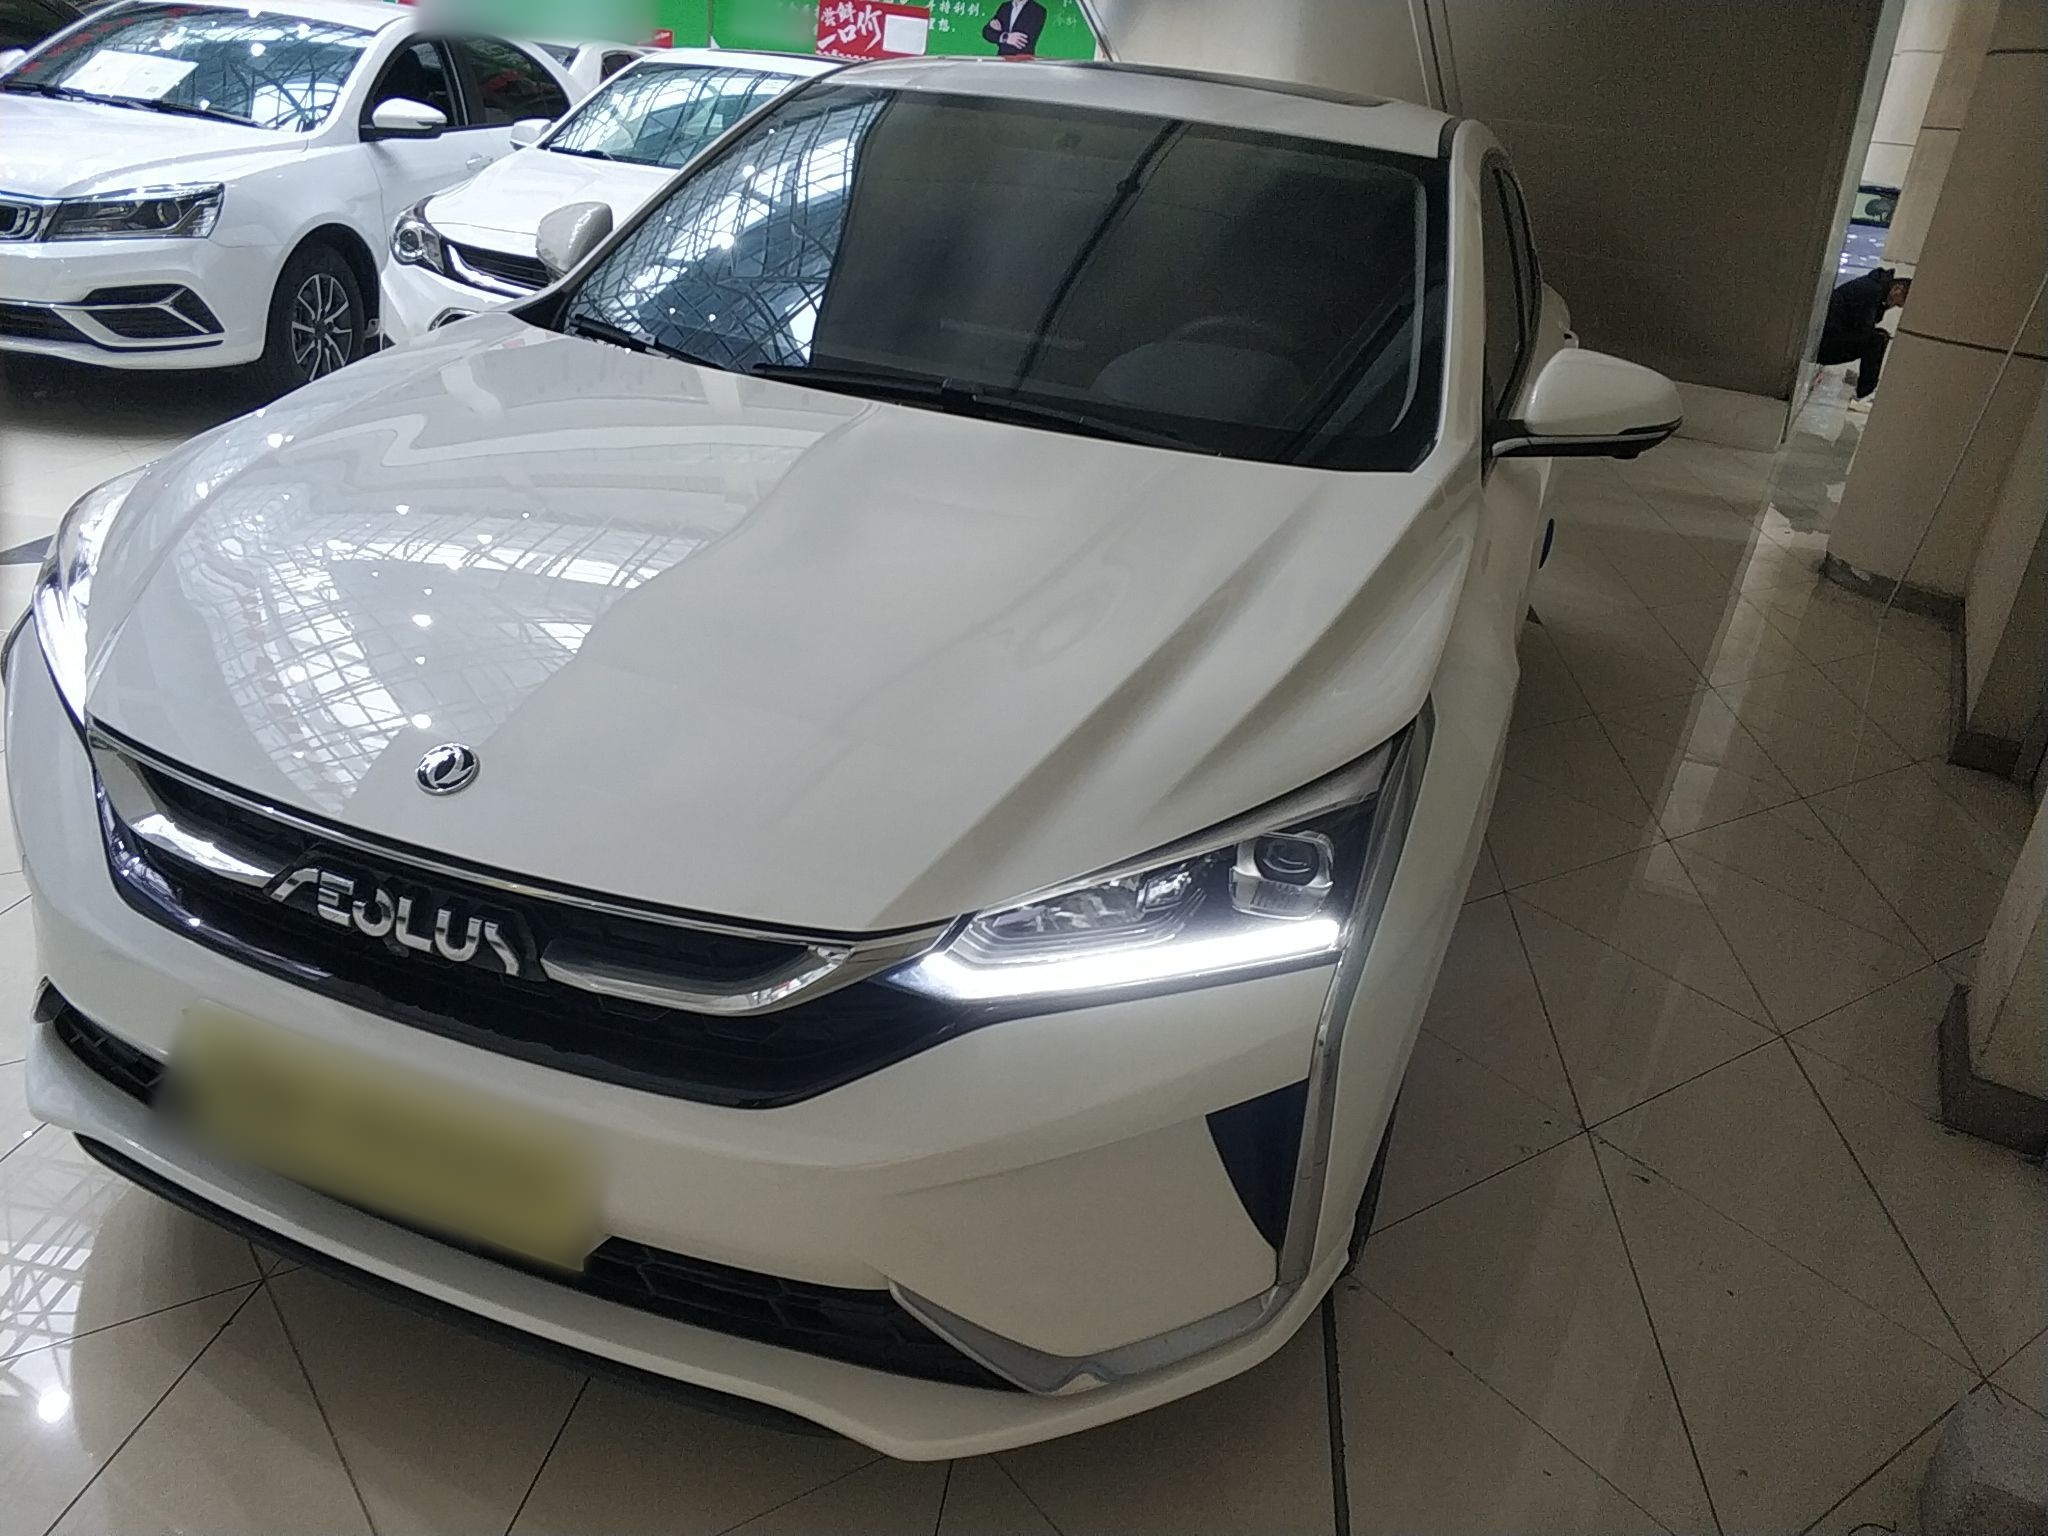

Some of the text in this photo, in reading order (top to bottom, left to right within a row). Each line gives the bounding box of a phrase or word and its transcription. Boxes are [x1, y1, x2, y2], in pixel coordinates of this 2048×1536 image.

[817, 4, 883, 53] 一口价
[269, 867, 520, 977] AEOLUS
